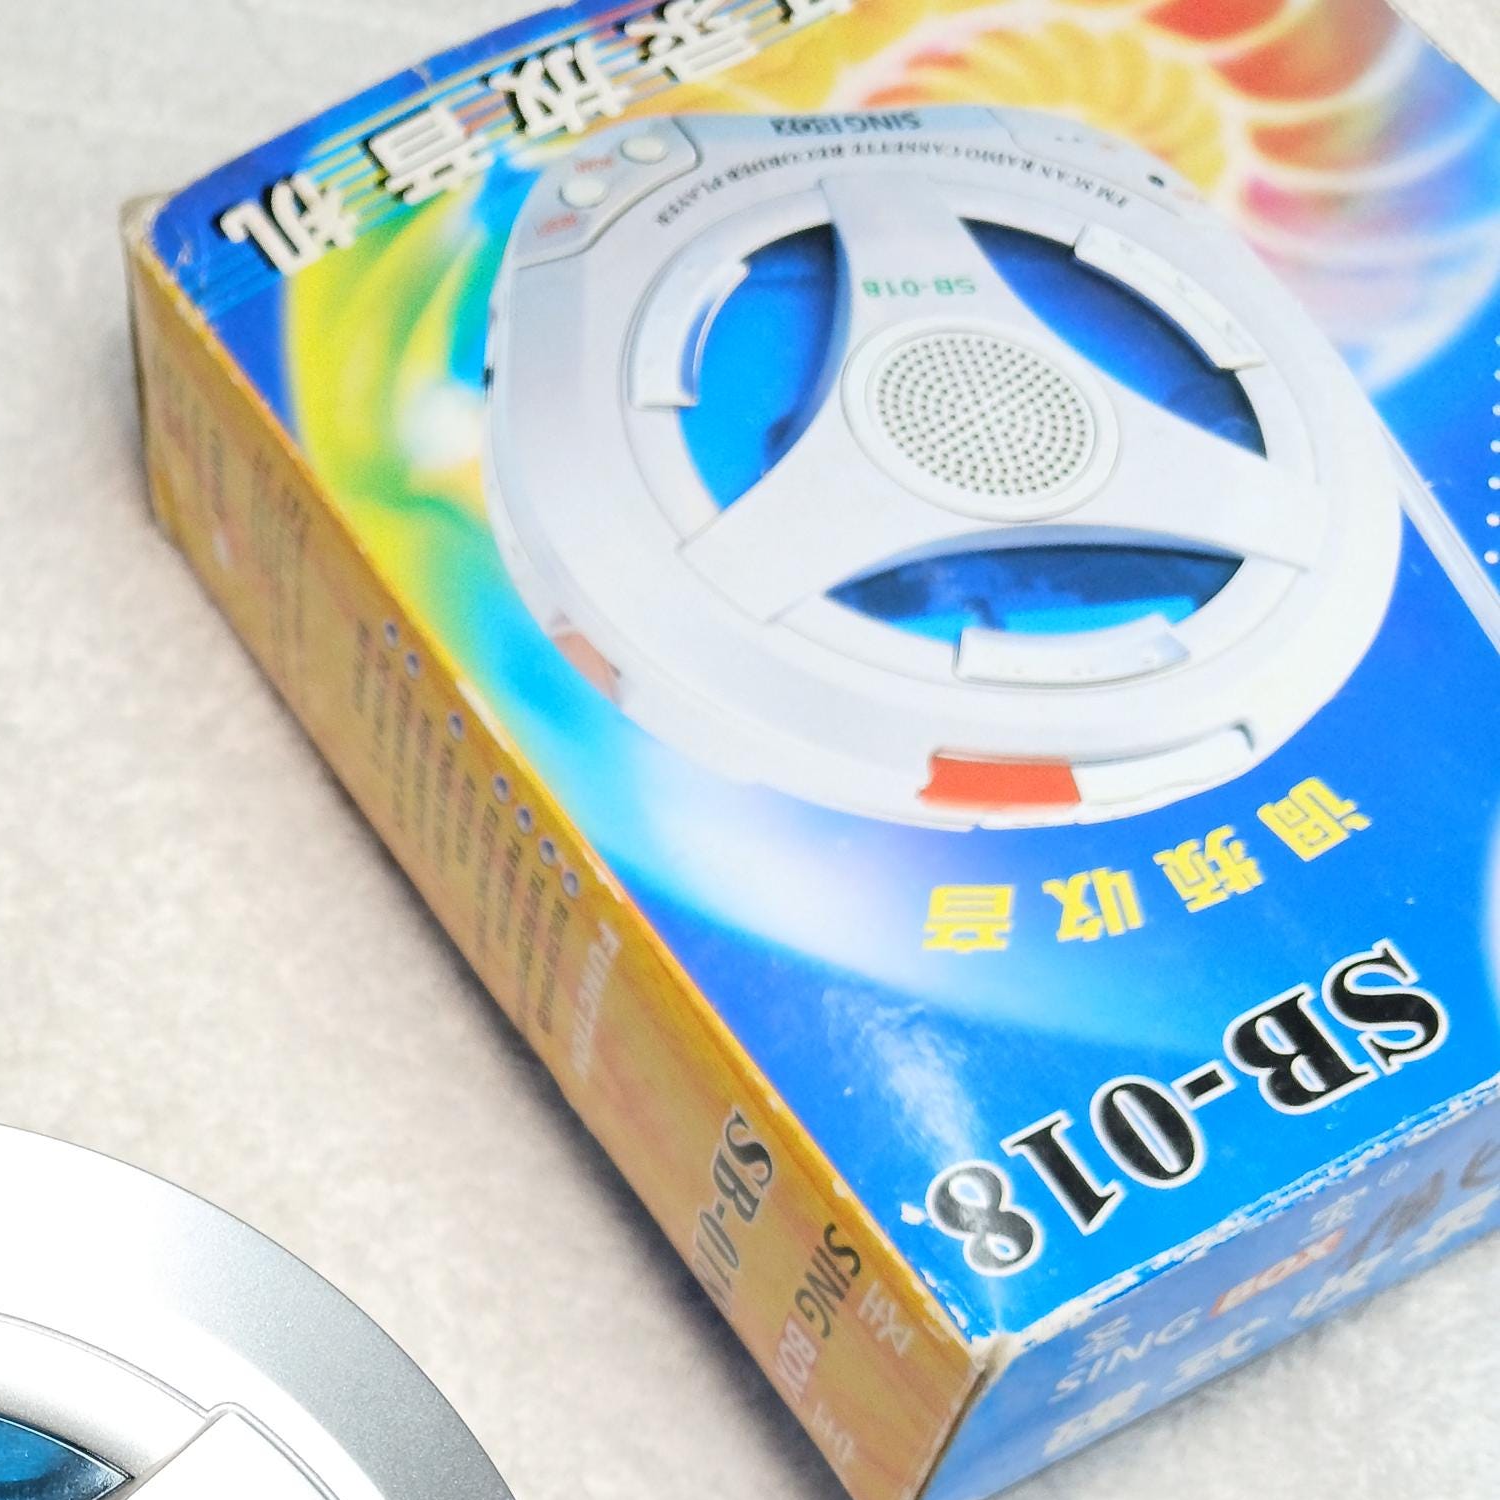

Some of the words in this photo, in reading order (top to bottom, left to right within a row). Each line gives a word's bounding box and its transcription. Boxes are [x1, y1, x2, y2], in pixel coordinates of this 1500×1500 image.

[221, 0, 850, 274] 录放音机
[726, 142, 845, 182] RECORDER
[965, 146, 1035, 176] RADIO
[656, 176, 723, 228] PLAYER
[922, 776, 1372, 953] 调频收音
[925, 938, 1449, 1277] SB-018
[795, 1222, 861, 1338] SING
[1049, 1306, 1200, 1404] SING
